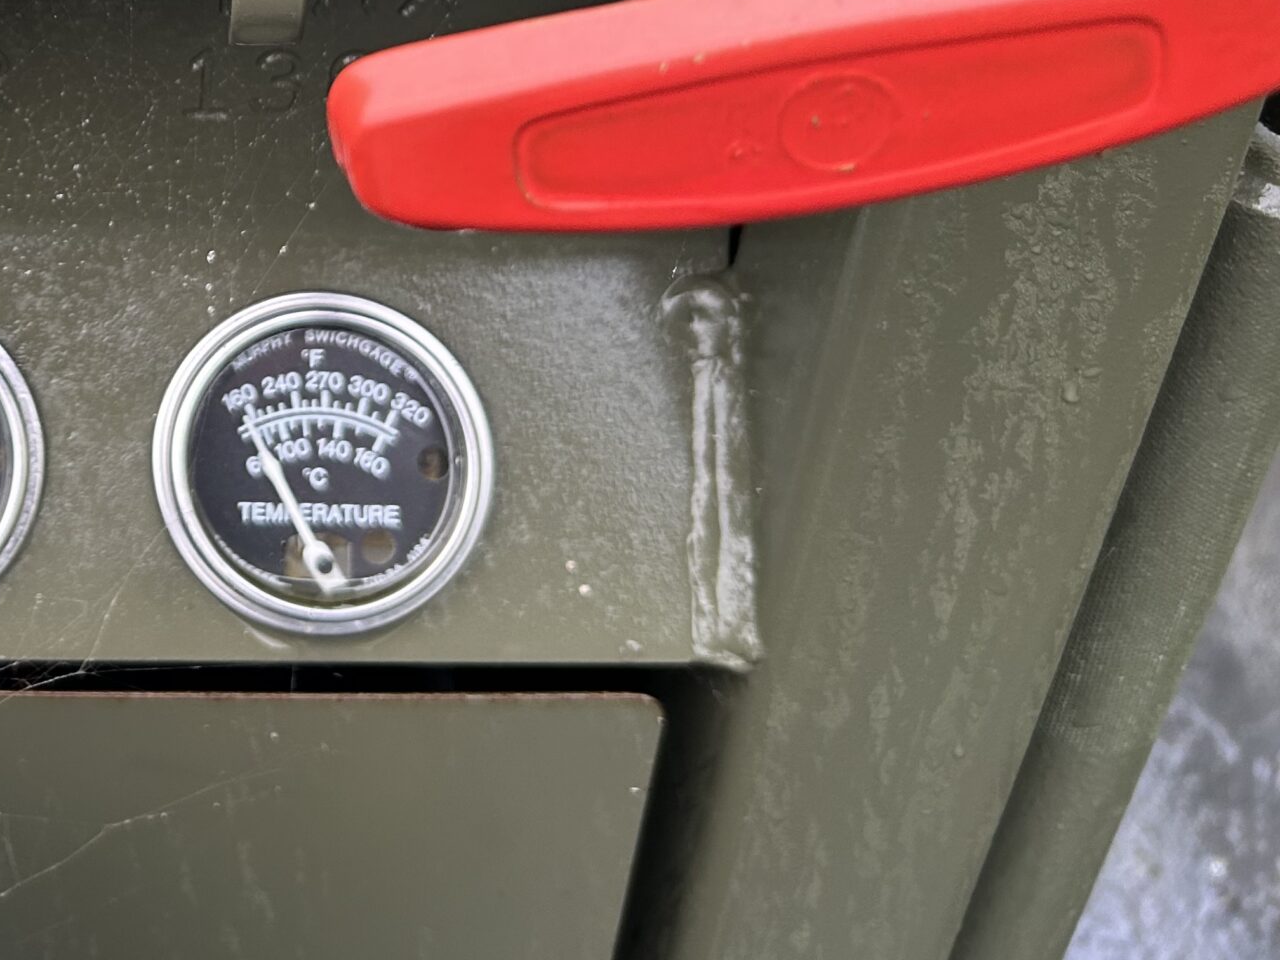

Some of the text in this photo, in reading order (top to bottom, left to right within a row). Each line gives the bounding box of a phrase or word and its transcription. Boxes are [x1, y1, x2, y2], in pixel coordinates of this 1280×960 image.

[183, 45, 370, 121] 13
[221, 370, 432, 428] 160 240 270 300 320
[274, 437, 312, 463] 100
[316, 437, 353, 463] 140
[353, 447, 391, 480] 160
[236, 500, 403, 529] TEMERATURE
